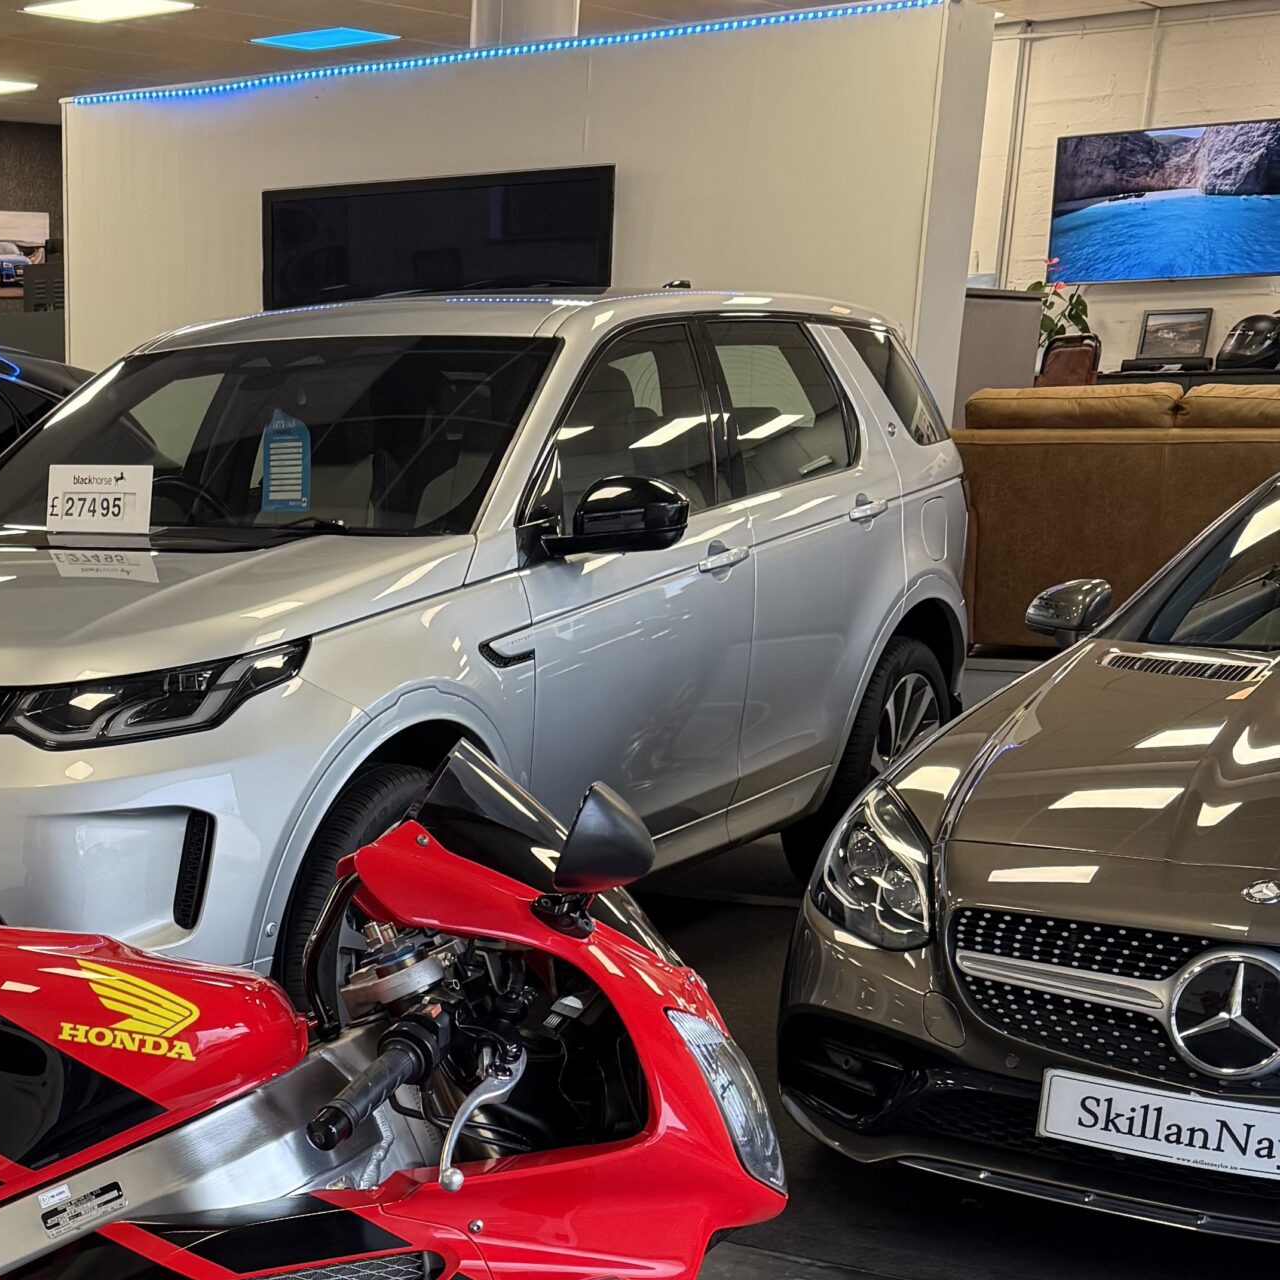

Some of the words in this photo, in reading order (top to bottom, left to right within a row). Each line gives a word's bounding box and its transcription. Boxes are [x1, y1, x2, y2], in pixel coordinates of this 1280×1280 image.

[73, 474, 113, 486] blackhorse
[49, 496, 122, 518] £27495
[58, 1022, 197, 1062] HONDA
[1076, 1094, 1280, 1170] SkillanNa
